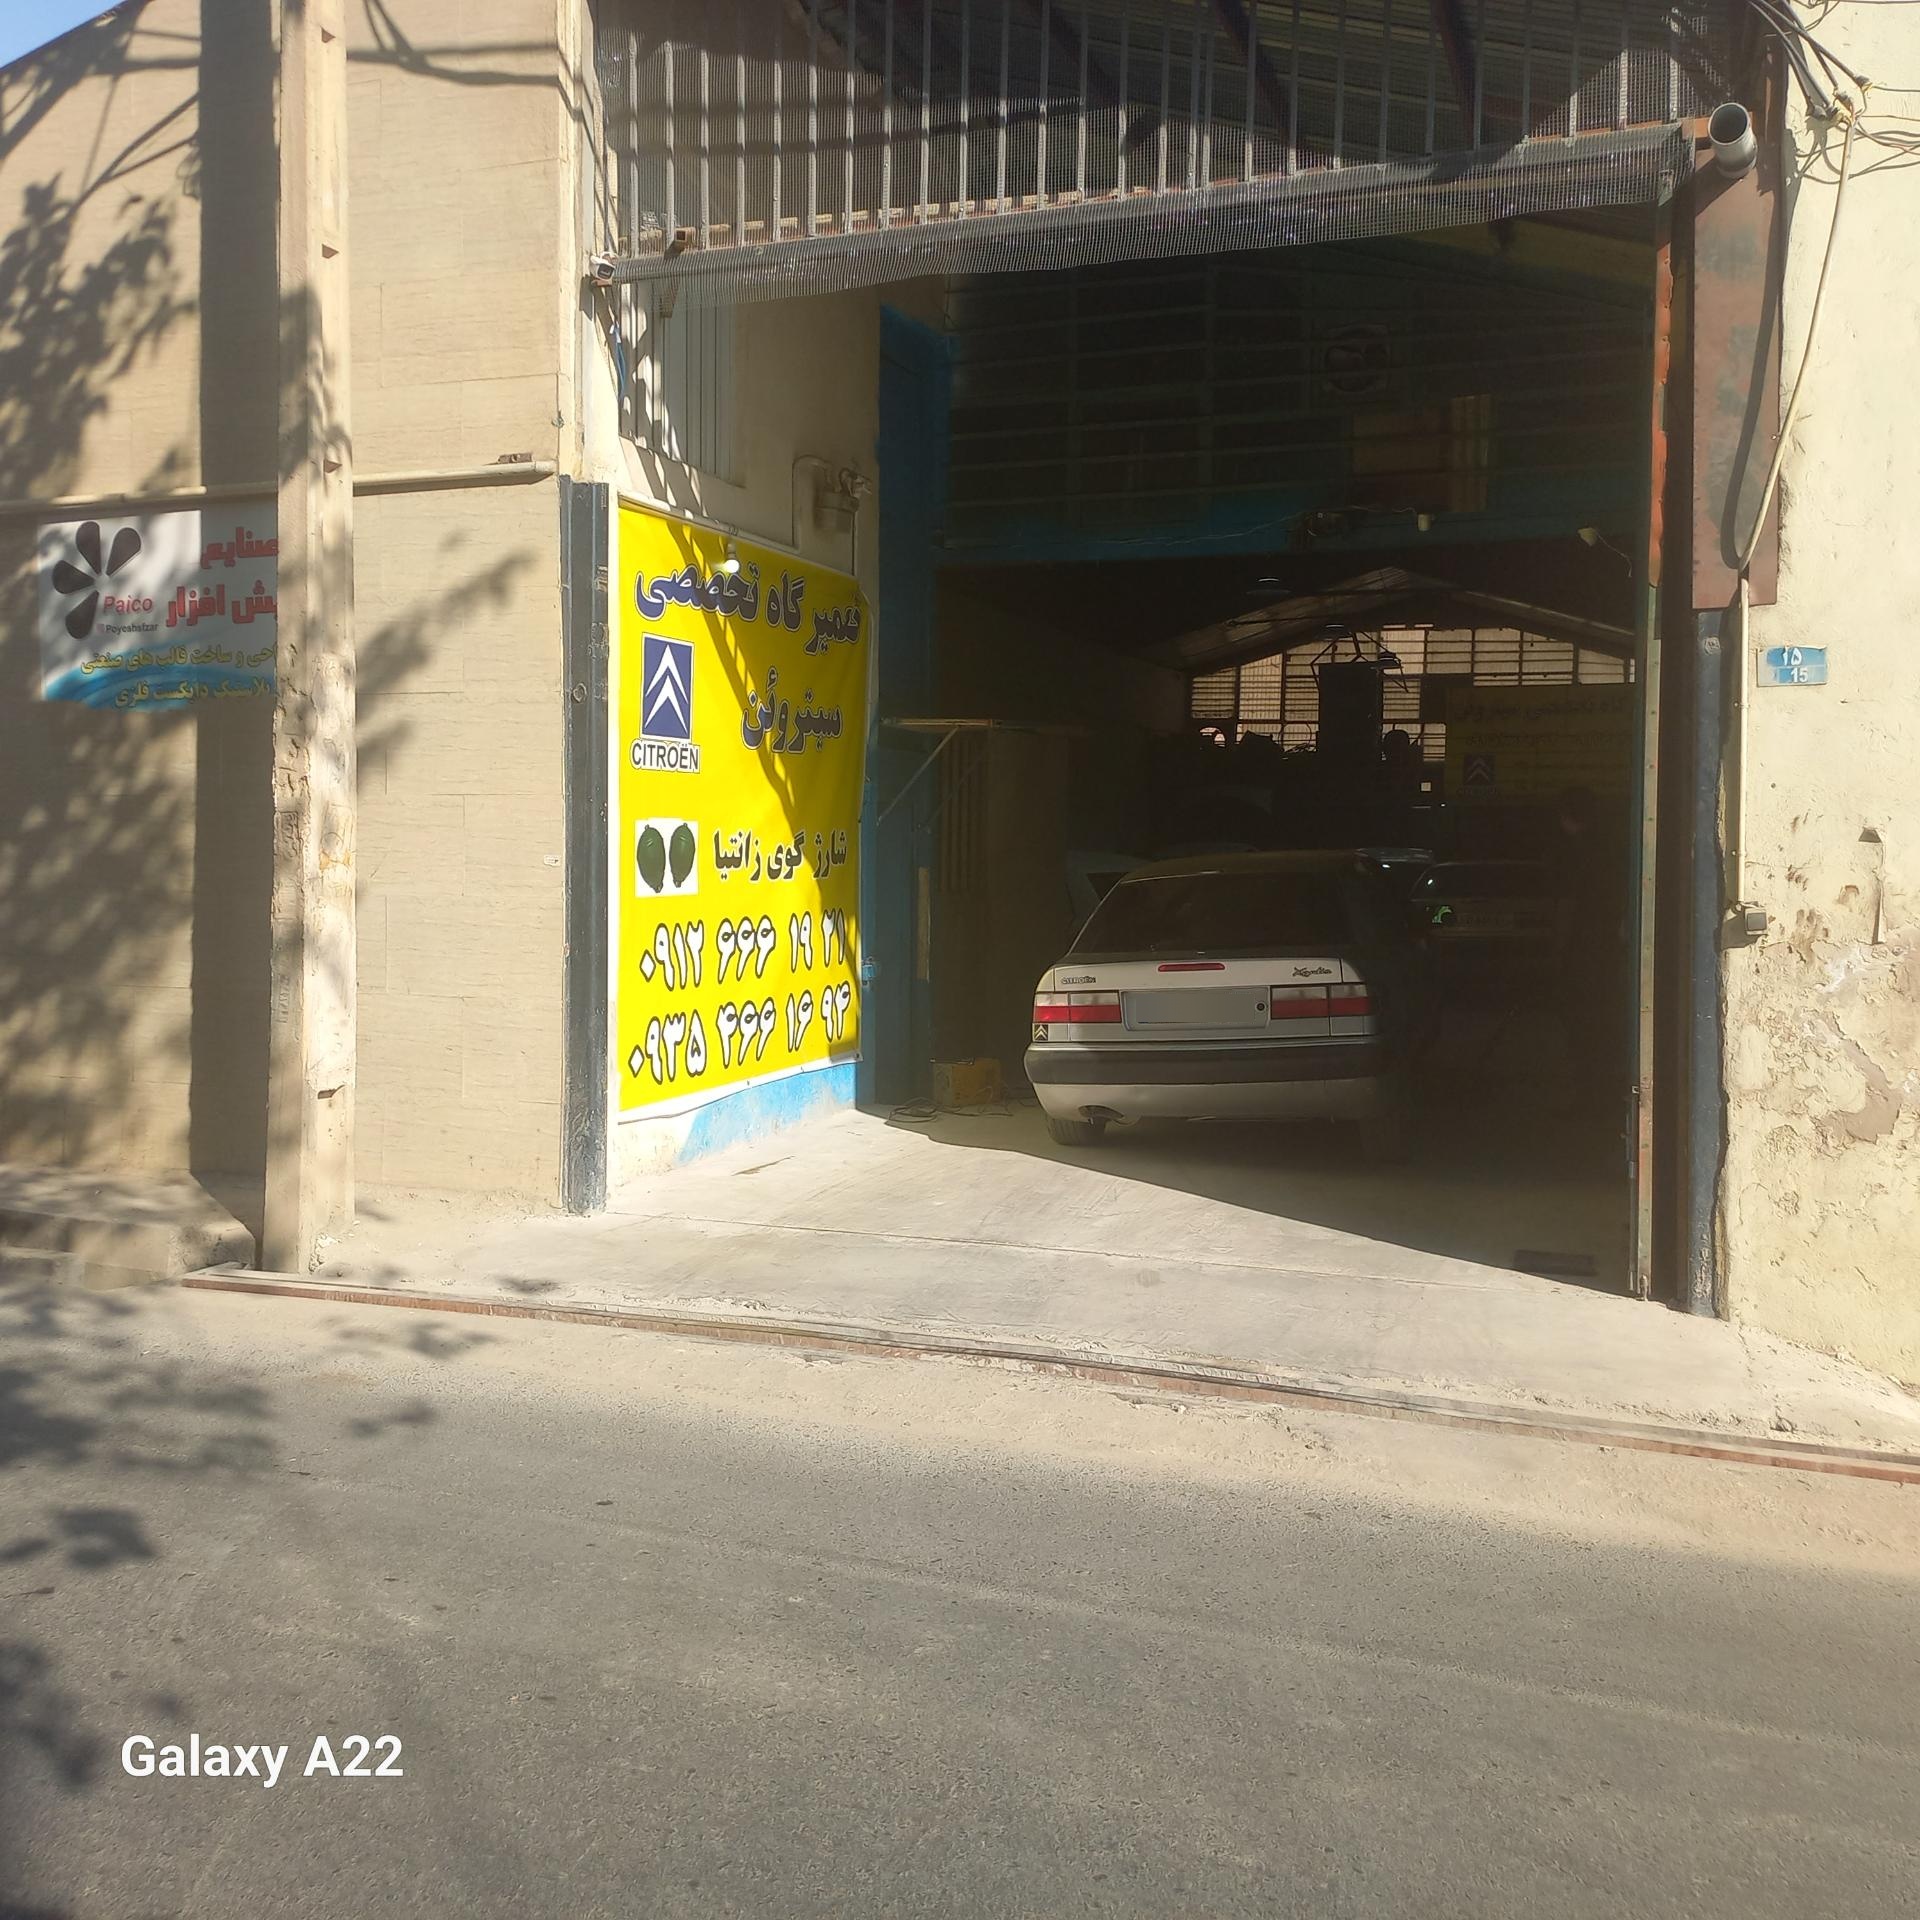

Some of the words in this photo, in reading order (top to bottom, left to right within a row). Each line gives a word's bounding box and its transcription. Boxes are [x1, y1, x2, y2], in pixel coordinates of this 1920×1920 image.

[103, 594, 153, 614] Paico
[167, 584, 225, 627] افزار
[635, 562, 759, 621] تخصصی
[766, 571, 805, 631] گاه
[81, 653, 123, 674] صنعتی
[126, 648, 155, 671] های
[156, 645, 187, 670] قالب
[191, 644, 232, 664] ساخت
[1791, 667, 1808, 683] 15
[115, 681, 150, 708] فلزی
[632, 742, 699, 771] CITROËN
[714, 830, 761, 880] زانتیا
[767, 831, 805, 880] گوی
[813, 831, 847, 878] شارژ
[640, 919, 704, 991] ۰۹۱۲
[716, 914, 776, 984] ۶۶۶
[789, 910, 813, 973] ۱۹
[822, 908, 845, 968] ۲۱
[629, 1009, 707, 1084] ۰۹۳۵
[716, 997, 776, 1068] ۴۶۶
[786, 989, 813, 1052] ۱۶
